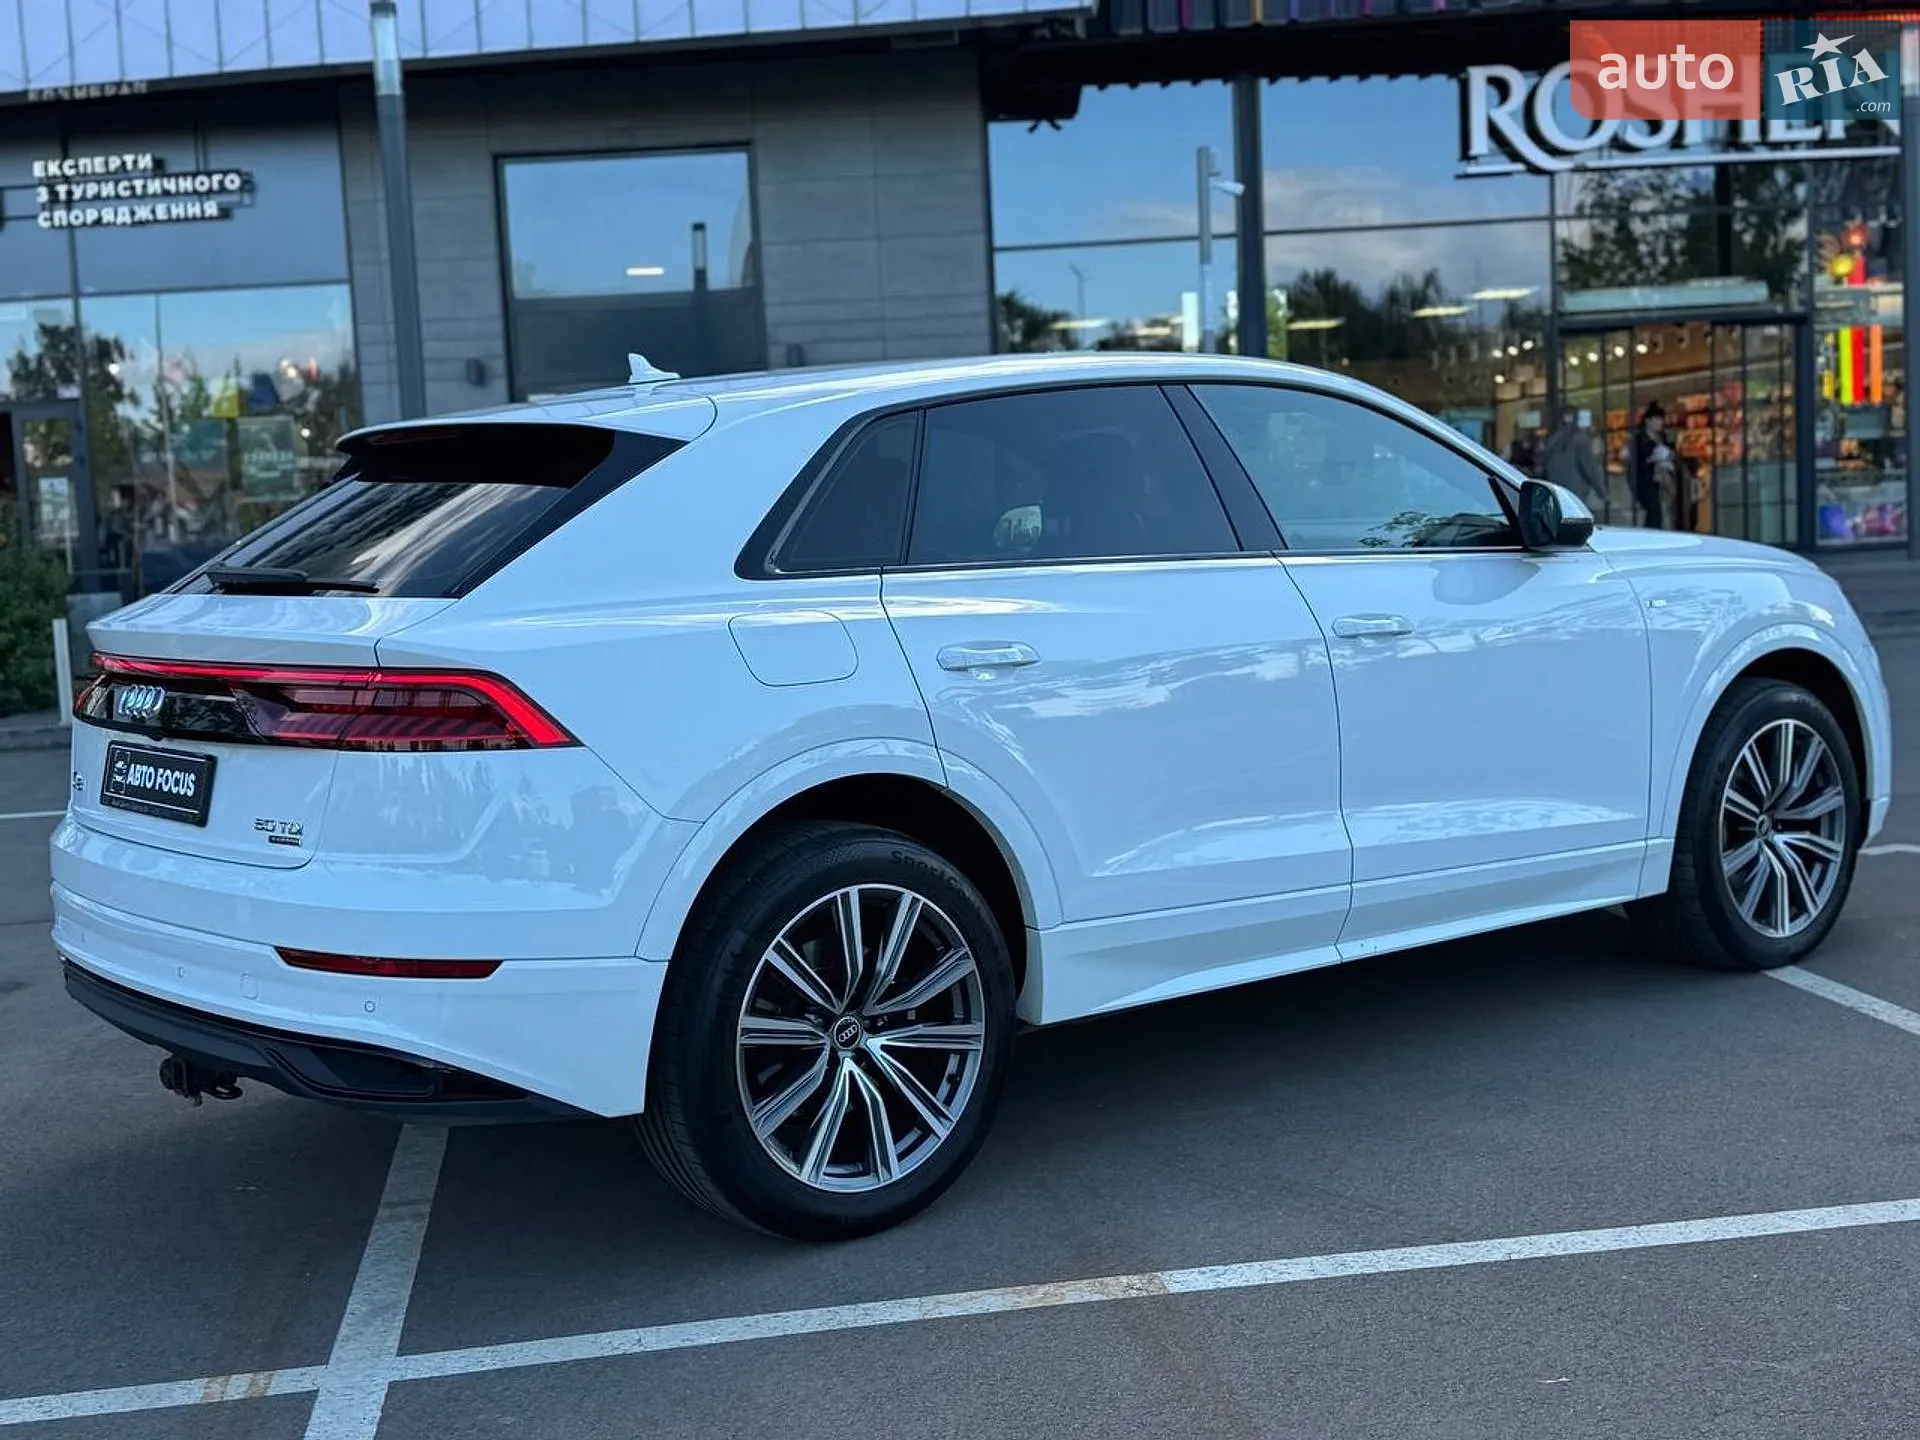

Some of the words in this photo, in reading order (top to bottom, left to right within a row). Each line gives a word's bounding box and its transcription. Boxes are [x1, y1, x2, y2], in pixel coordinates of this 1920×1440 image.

[1466, 54, 1901, 171] ROSHEN
[32, 153, 154, 178] ЕКСПЕРТИ
[56, 173, 243, 202] ТУРИСТИЧНОГО
[37, 200, 220, 228] СПОРЯДЖЕННЯ
[155, 769, 196, 797] FOCUS
